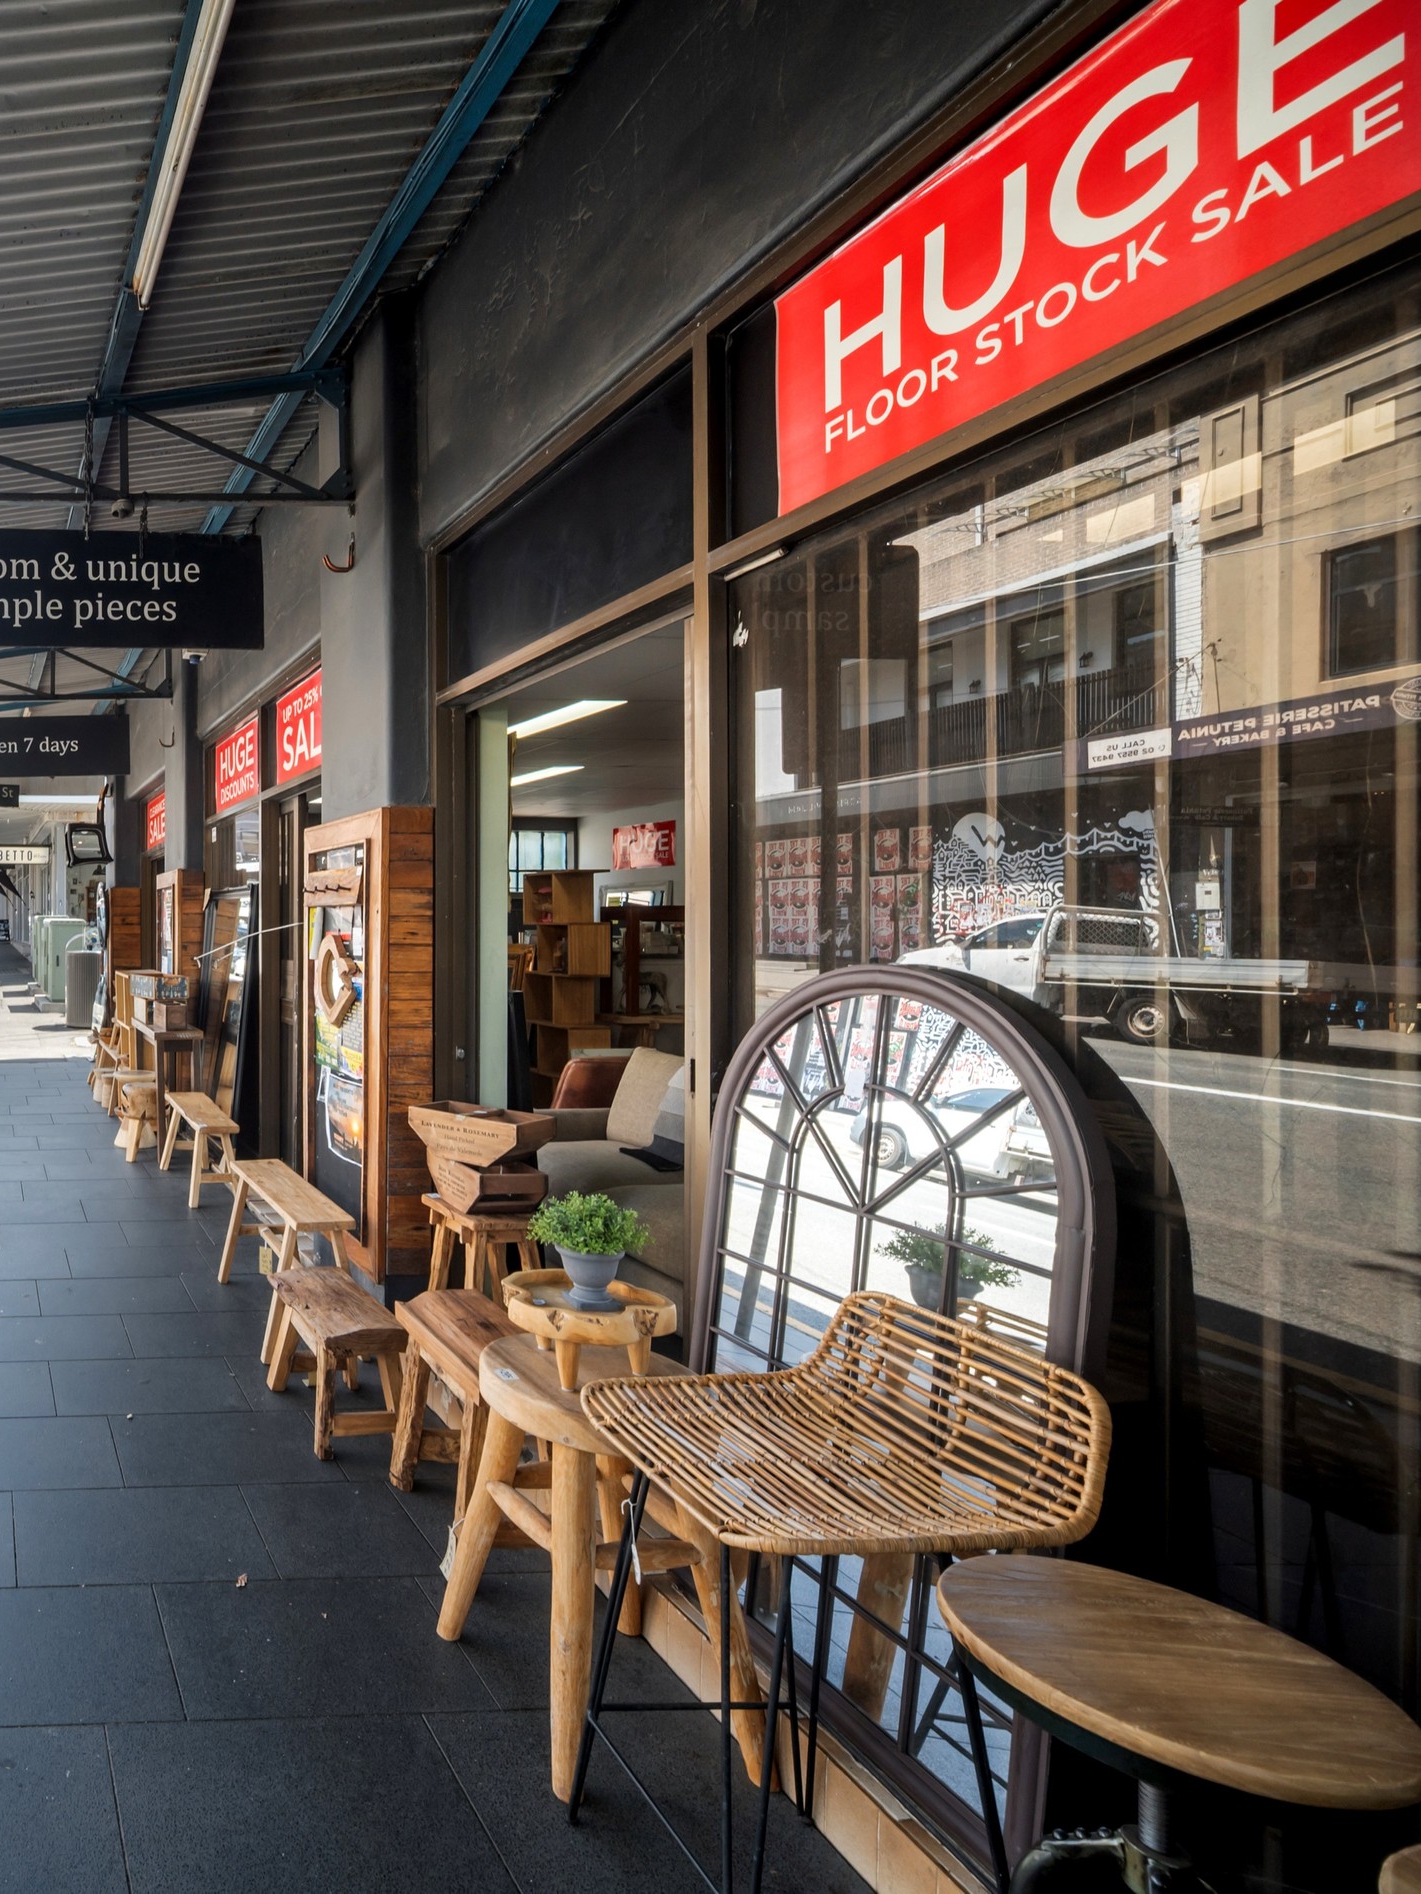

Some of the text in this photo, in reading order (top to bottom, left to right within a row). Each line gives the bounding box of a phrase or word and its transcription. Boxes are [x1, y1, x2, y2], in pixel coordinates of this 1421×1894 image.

[823, 0, 1405, 414] HUGE
[824, 81, 1404, 454] FLOOR STOCK SALE
[50, 552, 77, 581] &
[86, 554, 200, 590] unique
[73, 592, 177, 628] pieces
[282, 705, 292, 724] UP
[293, 700, 303, 718] TO
[304, 688, 319, 709] 25%
[24, 738, 34, 753] 7
[39, 736, 79, 756] days
[220, 729, 254, 783] HUGE
[283, 711, 322, 771] SAL
[2, 786, 14, 798] St
[220, 771, 255, 805] DISCOUNTS
[150, 812, 166, 844] SALE
[620, 830, 669, 854] HUGE
[421, 1120, 455, 1131] LAVENDER
[463, 1127, 500, 1138] ROSEMARY
